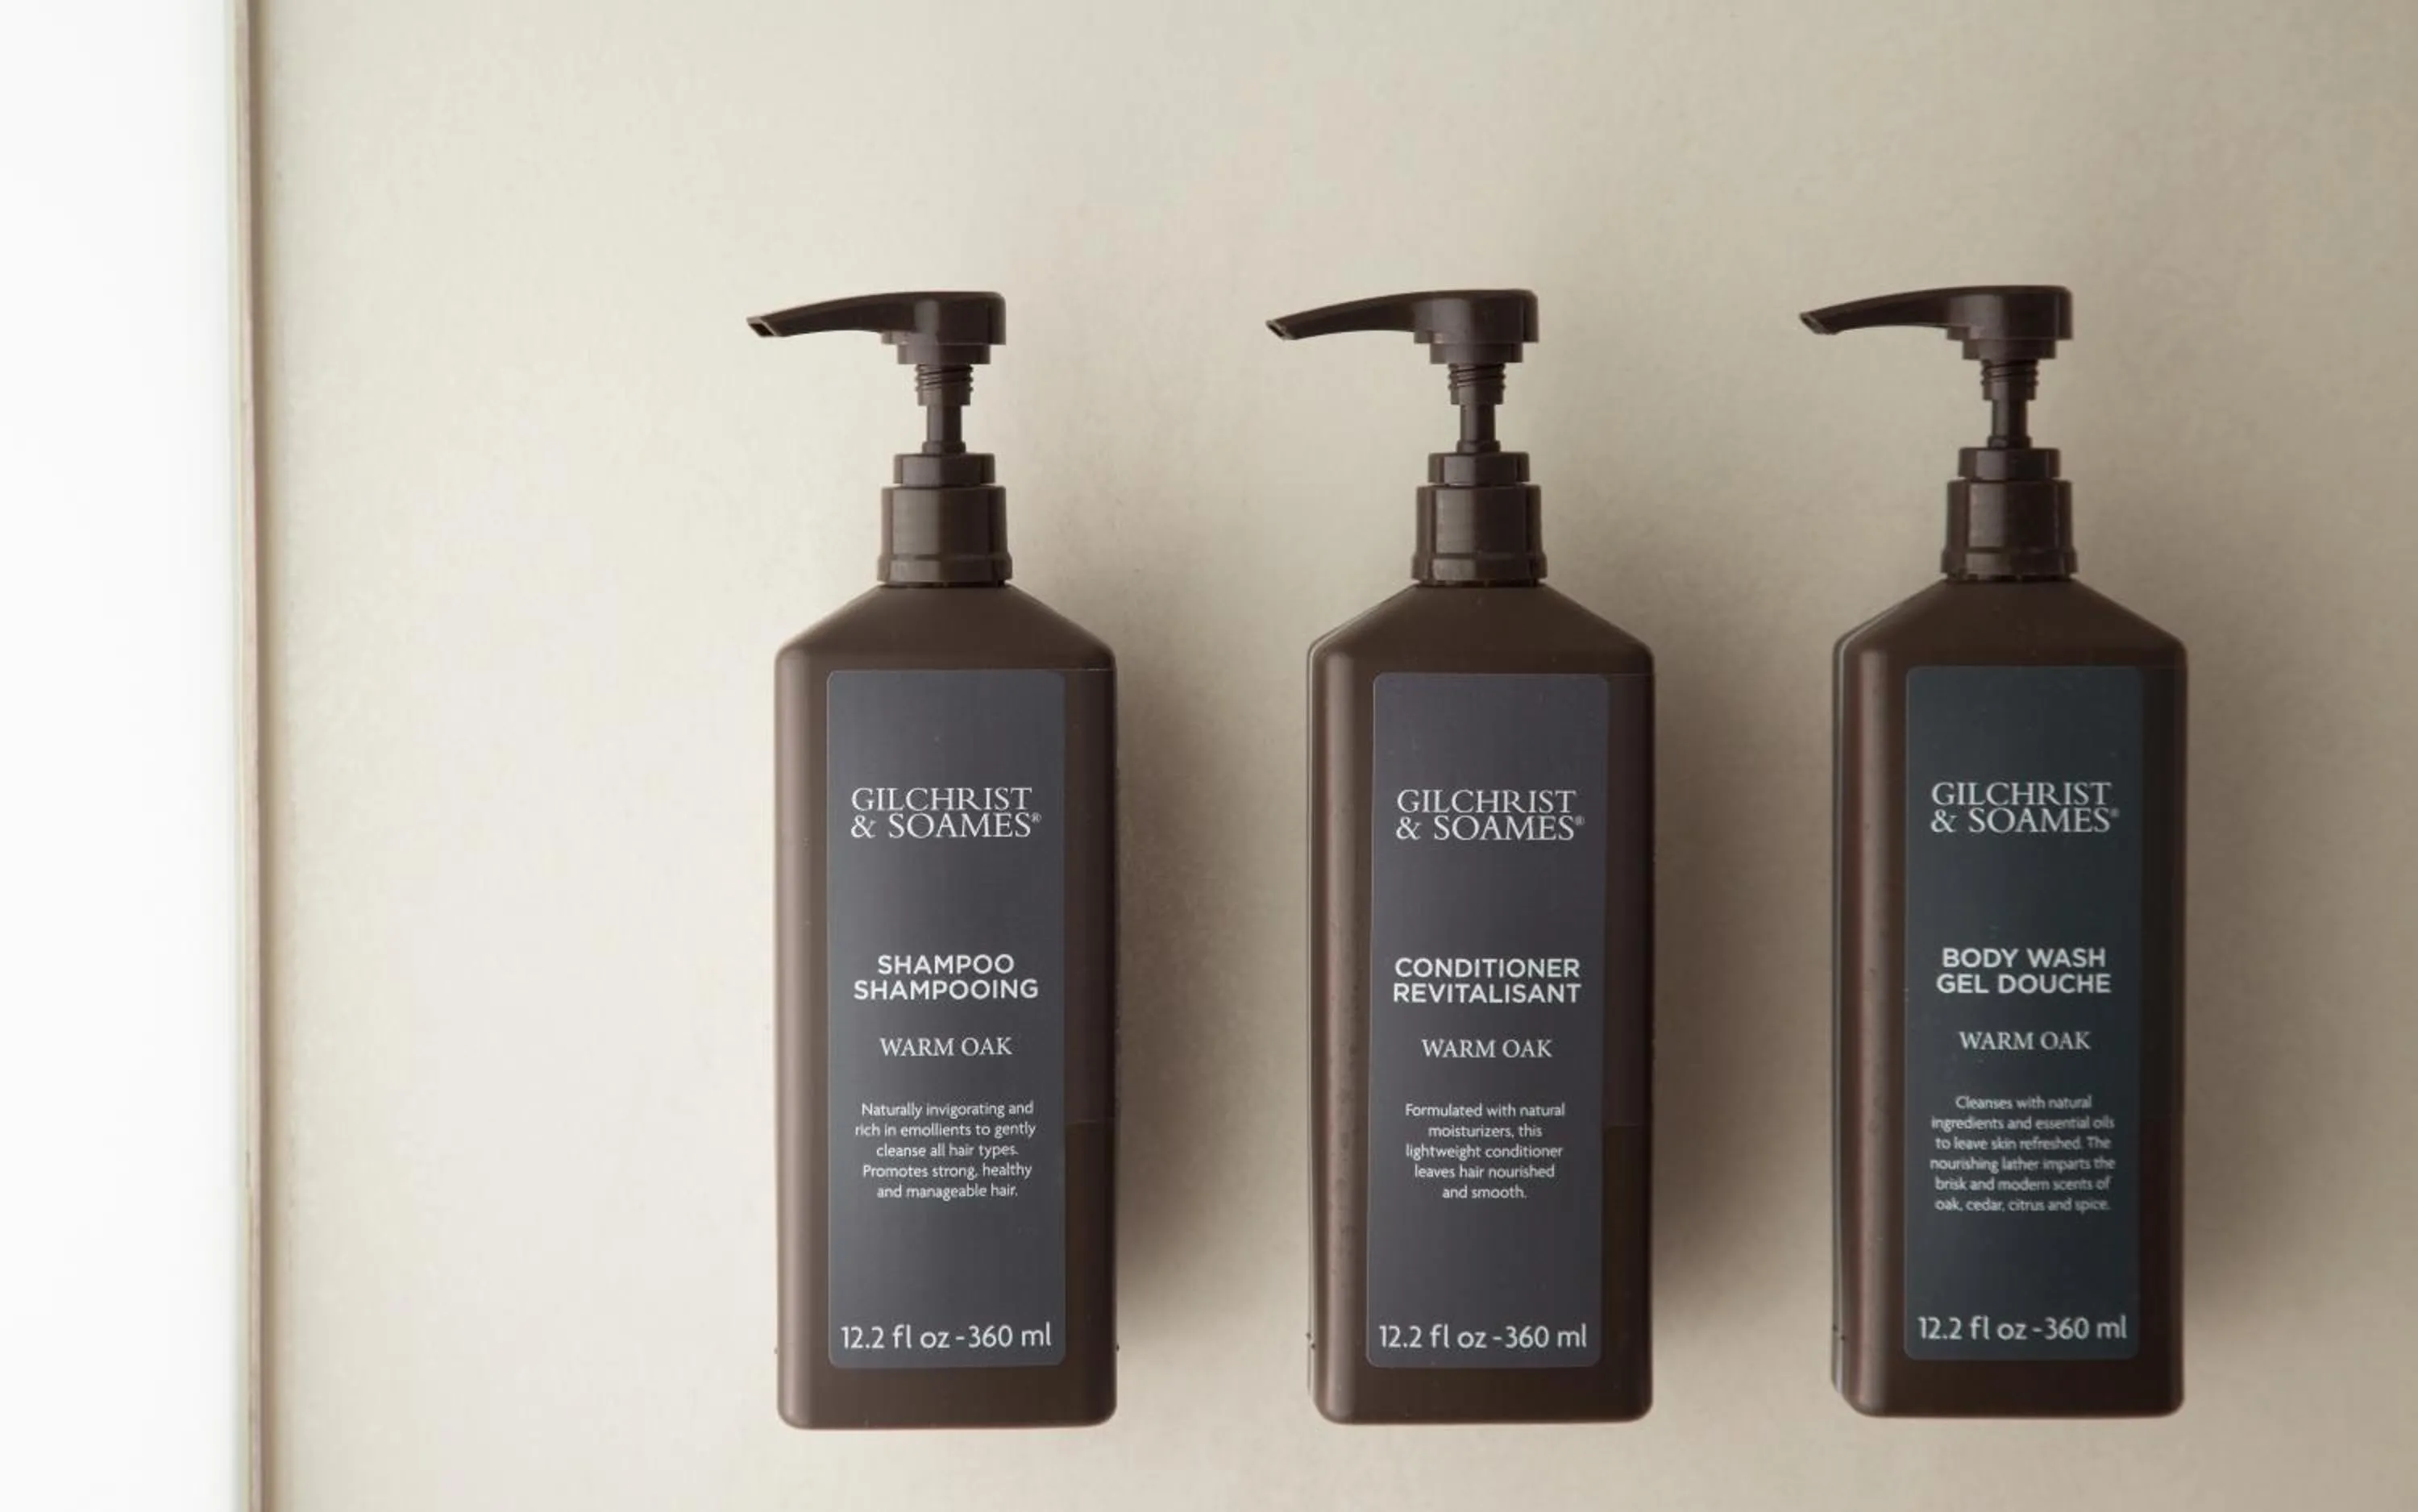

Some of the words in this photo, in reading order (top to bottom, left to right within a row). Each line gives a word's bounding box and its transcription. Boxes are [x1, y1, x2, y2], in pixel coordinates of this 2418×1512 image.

[851, 787, 1032, 811] GILCHRIST
[1398, 790, 1576, 813] GILCHRIST
[1932, 782, 2112, 806] GILCHRIST
[851, 812, 875, 838] &
[1396, 816, 1420, 840] &
[1931, 809, 1957, 833] &
[879, 954, 1014, 974] SHAMPOO
[1942, 948, 2018, 968] BODY
[2026, 948, 2105, 967] WASH
[1395, 957, 1580, 978] CONDITIONER
[854, 978, 1038, 999] SHAMPOOING
[1394, 982, 1581, 1003] REVITALISANT
[1936, 974, 1989, 993] GEL
[1998, 973, 2111, 994] DOUCHE
[880, 1038, 954, 1056] WARM
[962, 1037, 1012, 1056] OAK
[1422, 1039, 1496, 1057] WARM
[1502, 1040, 1552, 1057] OAK
[1959, 1032, 2034, 1049] WARM
[2040, 1032, 2091, 1050] OAK
[862, 1103, 922, 1119] Naturally
[927, 1103, 1005, 1119] invigorating
[1008, 1101, 1033, 1114] and
[1406, 1103, 1482, 1117] Formulated
[1486, 1103, 1516, 1117] with
[1520, 1103, 1565, 1116] natural
[1955, 1096, 2013, 1109] Cleanses
[2016, 1096, 2046, 1109] with
[2048, 1095, 2092, 1109] natural
[855, 1124, 880, 1136] rich
[885, 1124, 896, 1136] in
[900, 1123, 971, 1136] emollients
[975, 1125, 991, 1135] to
[995, 1121, 1036, 1139] gently
[1428, 1125, 1514, 1138] moisturizers,
[1518, 1124, 1543, 1136] this
[1931, 1116, 2004, 1132] ingredients
[2007, 1116, 2032, 1129] and
[2035, 1115, 2090, 1129] essential
[2092, 1115, 2115, 1128] oils
[877, 1144, 926, 1157] cleanse
[930, 1143, 945, 1157] all
[949, 1144, 974, 1157] hair
[1935, 1138, 1951, 1149] to
[1954, 1136, 1988, 1149] leave
[1992, 1137, 2017, 1149] skin
[2087, 1136, 2112, 1149] The
[1406, 1144, 1481, 1161] lightweight
[1485, 1144, 1563, 1157] conditioner
[863, 1165, 929, 1178] Promotes
[983, 1162, 1032, 1179] healthy
[1415, 1164, 1456, 1178] leaves
[1460, 1164, 1485, 1178] hair
[1489, 1164, 1555, 1178] nourished
[1930, 1157, 1999, 1173] nourishing
[2002, 1157, 2039, 1170] lather
[2042, 1159, 2092, 1173] imparts
[2093, 1156, 2116, 1169] the
[1442, 1185, 1467, 1198] and
[1472, 1185, 1527, 1198] smooth.
[1935, 1177, 1967, 1190] brisk
[1969, 1178, 1995, 1190] and
[2053, 1179, 2093, 1190] scents
[2096, 1175, 2112, 1190] of
[877, 1184, 902, 1198] and
[906, 1183, 987, 1201] manageable
[991, 1183, 1017, 1196] hair.
[2008, 1199, 2045, 1211] citrus
[2047, 1198, 2072, 1211] and
[841, 1326, 885, 1348] 12.2
[892, 1324, 912, 1348] fl
[920, 1331, 949, 1348] oz
[1022, 1322, 1051, 1346] ml
[1379, 1325, 1422, 1348] 12.2
[1430, 1323, 1449, 1348] fl
[1457, 1331, 1487, 1348] oz
[1557, 1323, 1586, 1348] ml
[1918, 1316, 1962, 1340] 12.2
[1970, 1315, 1989, 1340] fl
[1996, 1323, 2027, 1340] oz
[2096, 1315, 2127, 1339] ml
